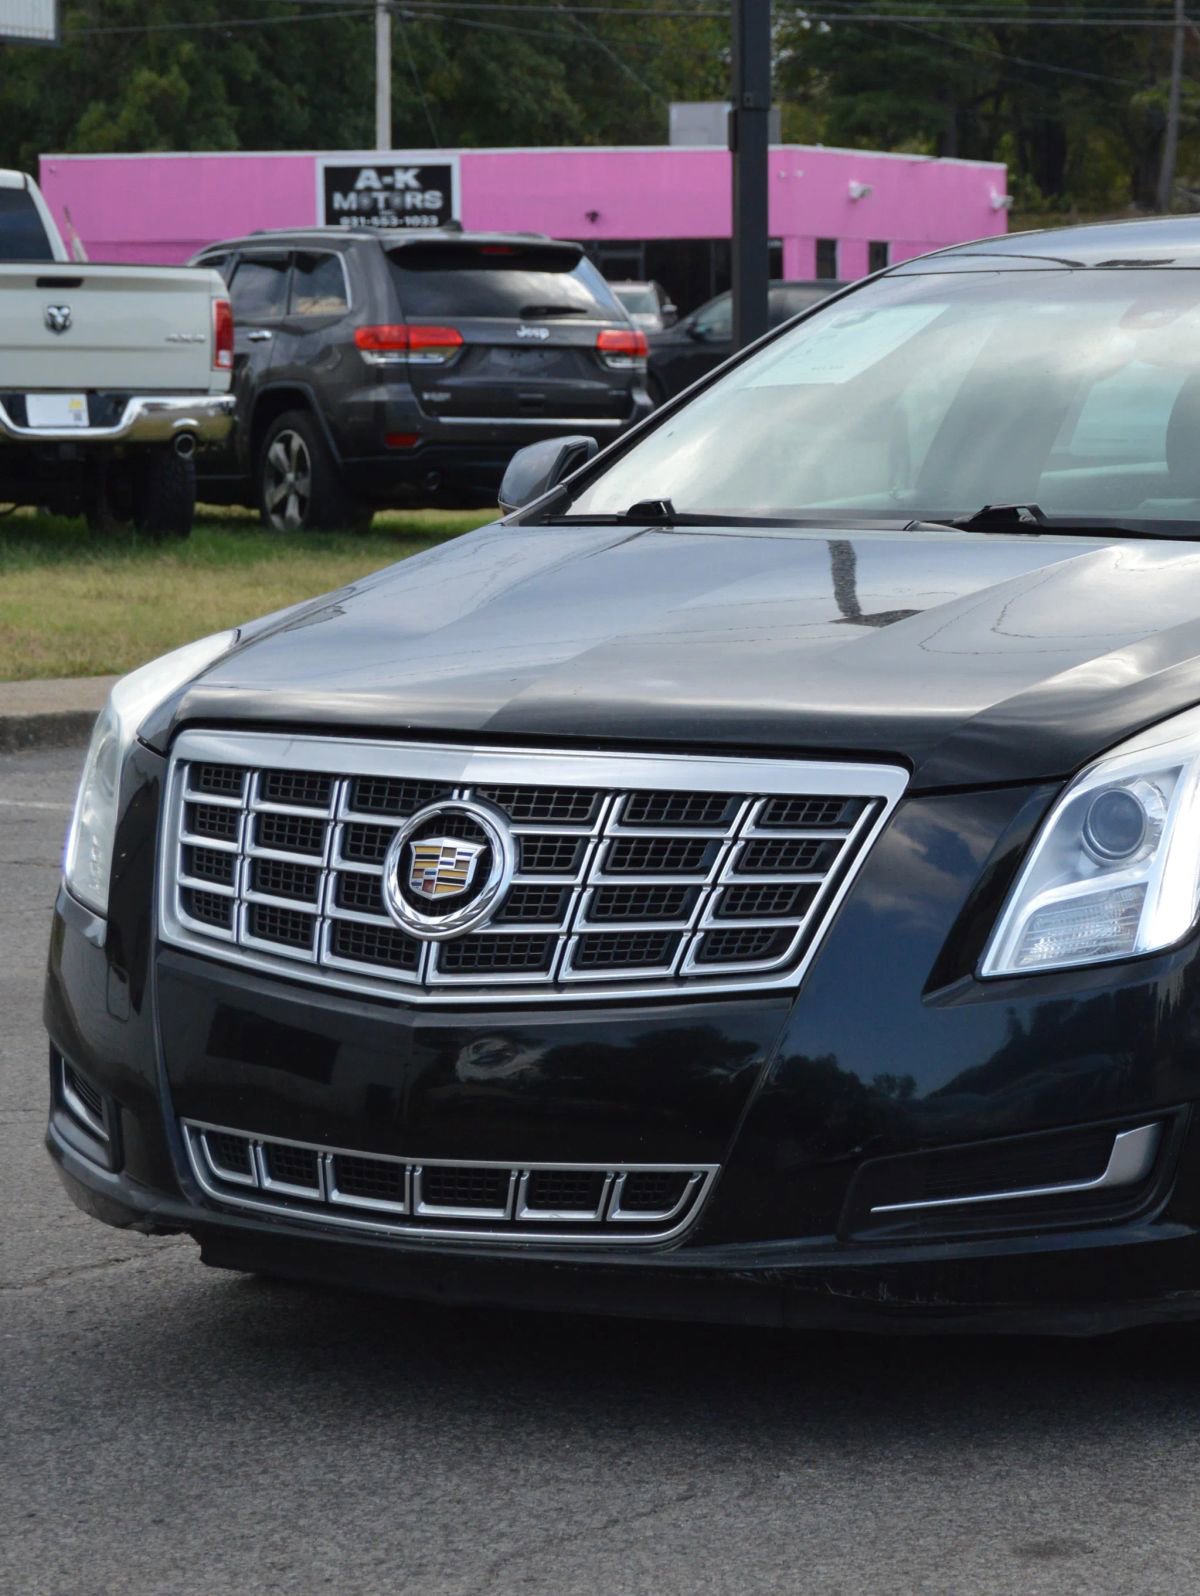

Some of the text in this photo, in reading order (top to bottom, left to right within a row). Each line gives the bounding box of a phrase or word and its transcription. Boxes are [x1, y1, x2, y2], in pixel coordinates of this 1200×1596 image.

[354, 168, 421, 190] A-K
[332, 190, 443, 211] MOTORS
[516, 325, 549, 340] Jeep
